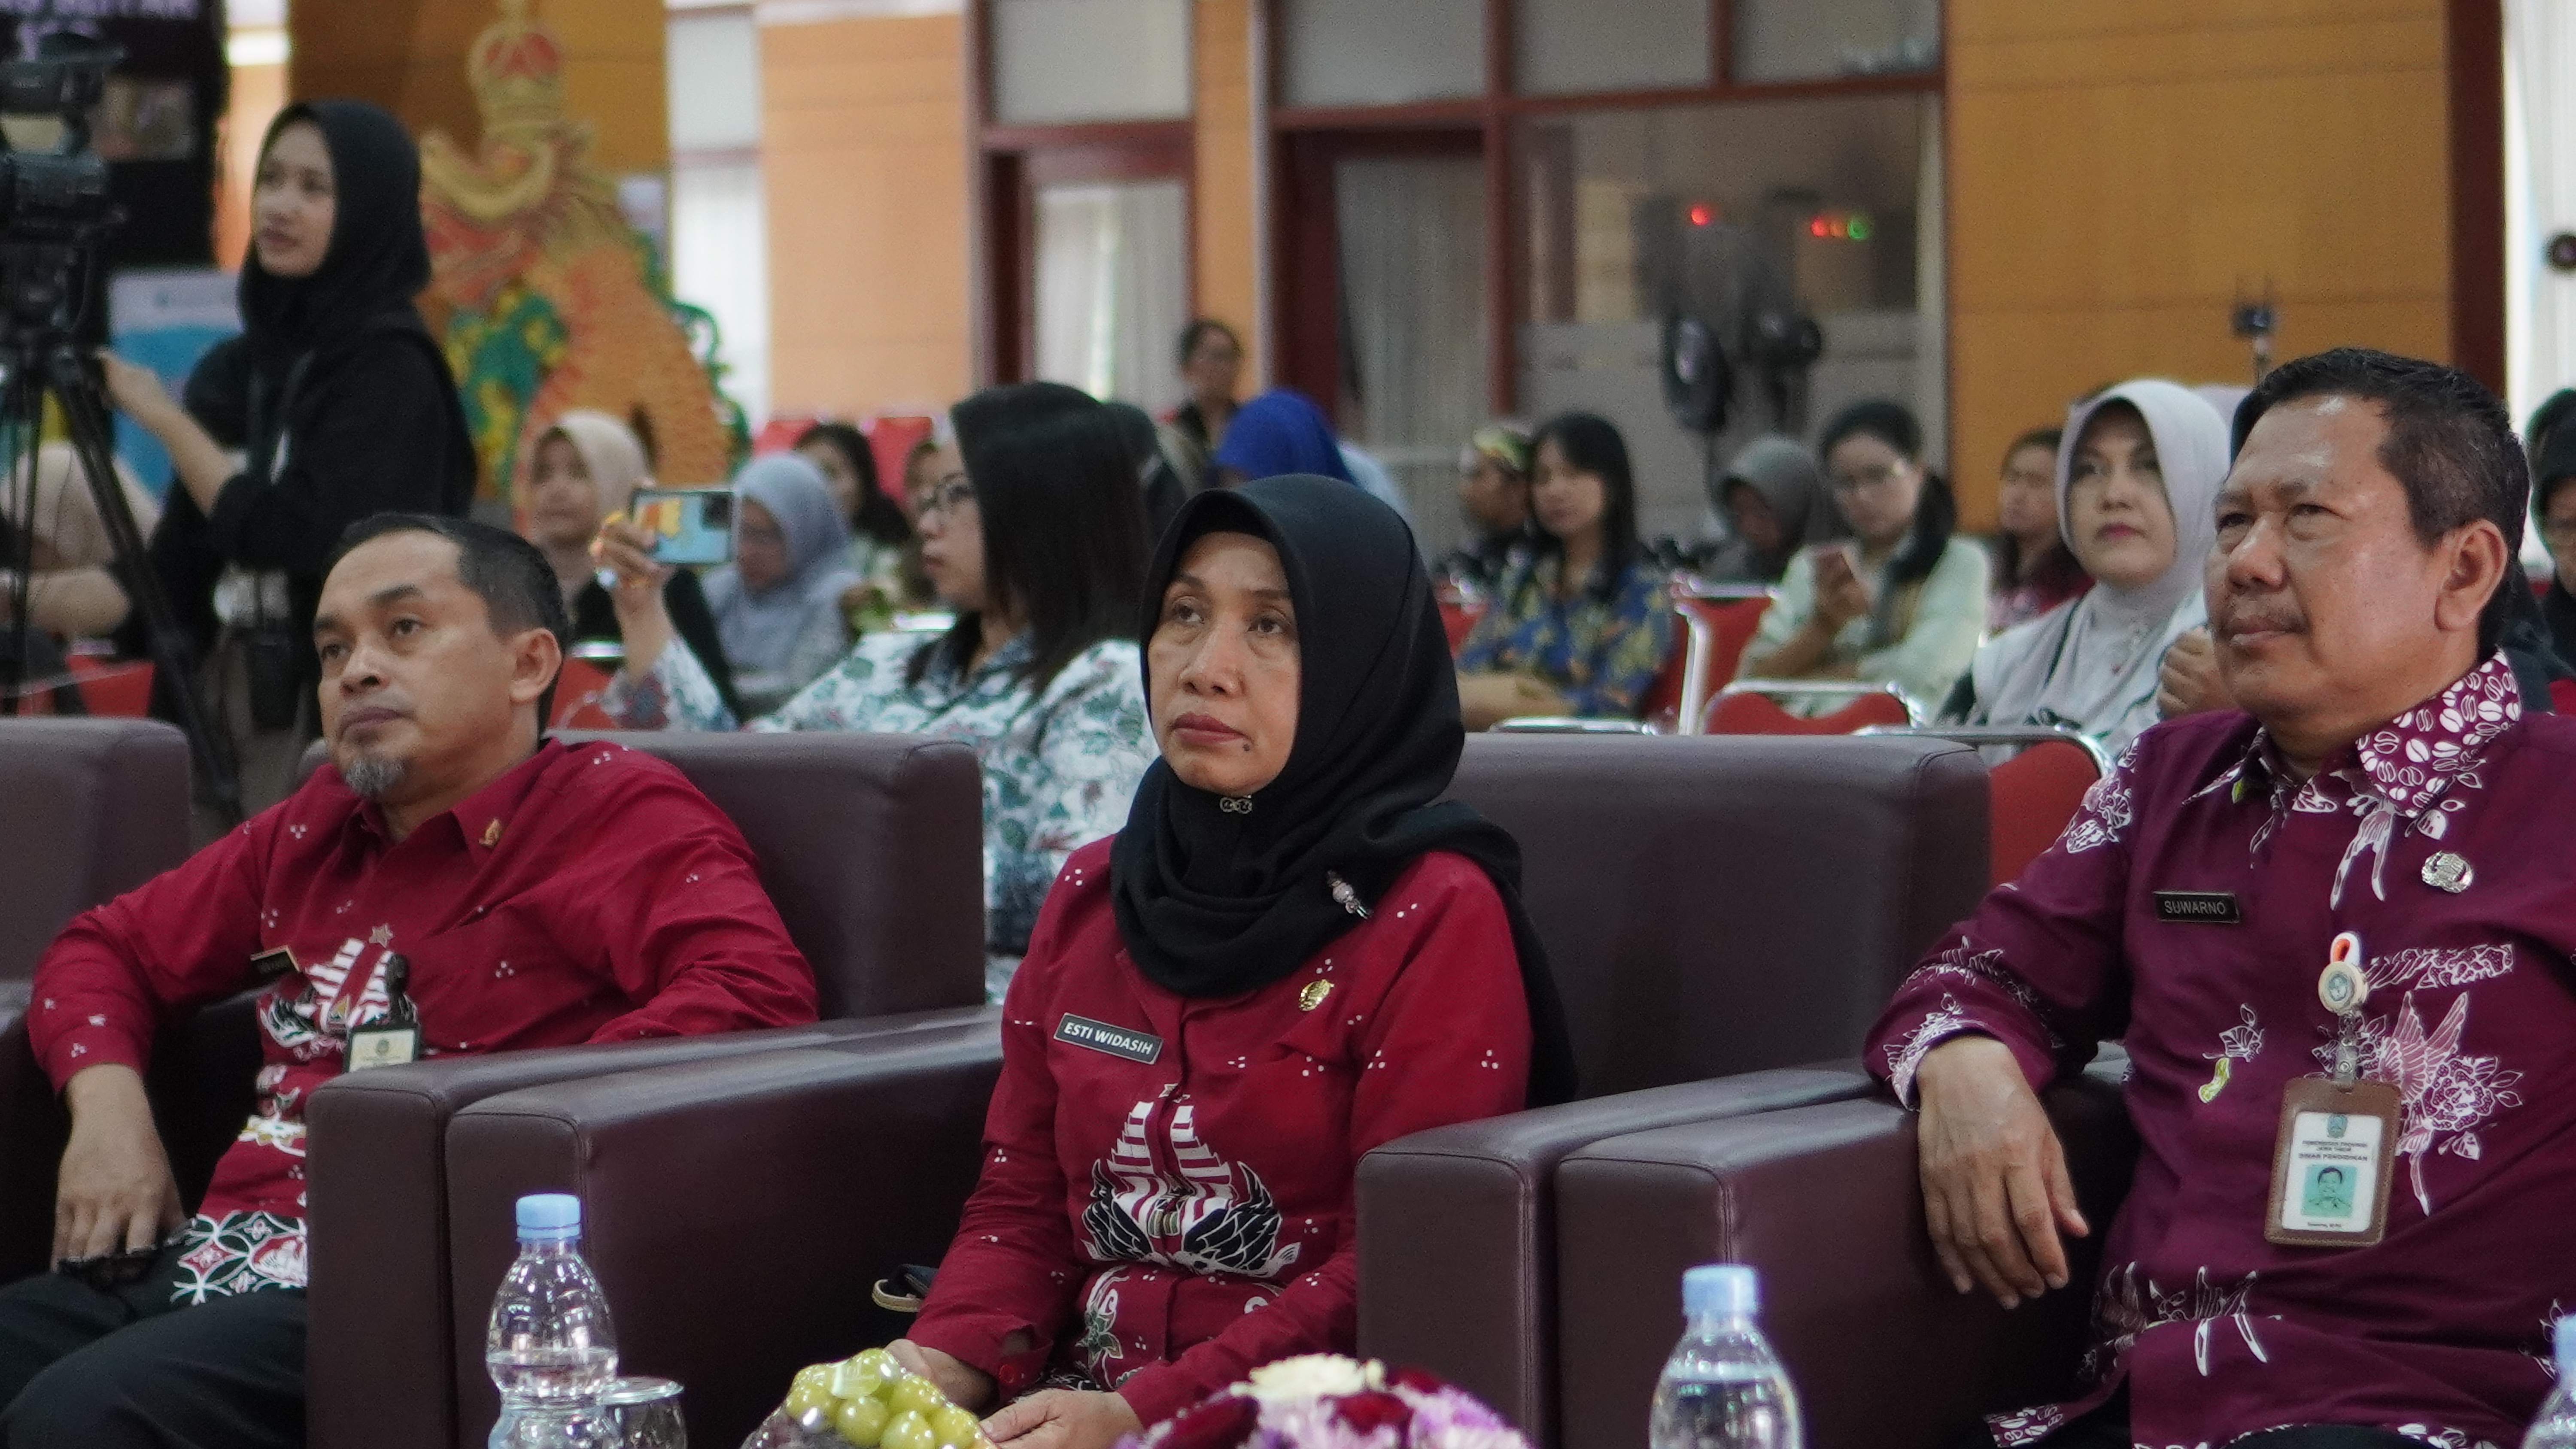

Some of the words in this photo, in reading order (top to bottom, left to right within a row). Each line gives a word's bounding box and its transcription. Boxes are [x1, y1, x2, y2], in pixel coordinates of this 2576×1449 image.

[2164, 900, 2226, 915] SUWARNO
[1063, 1022, 1094, 1040] ESTI
[1094, 1029, 1154, 1055] WIDASIH
